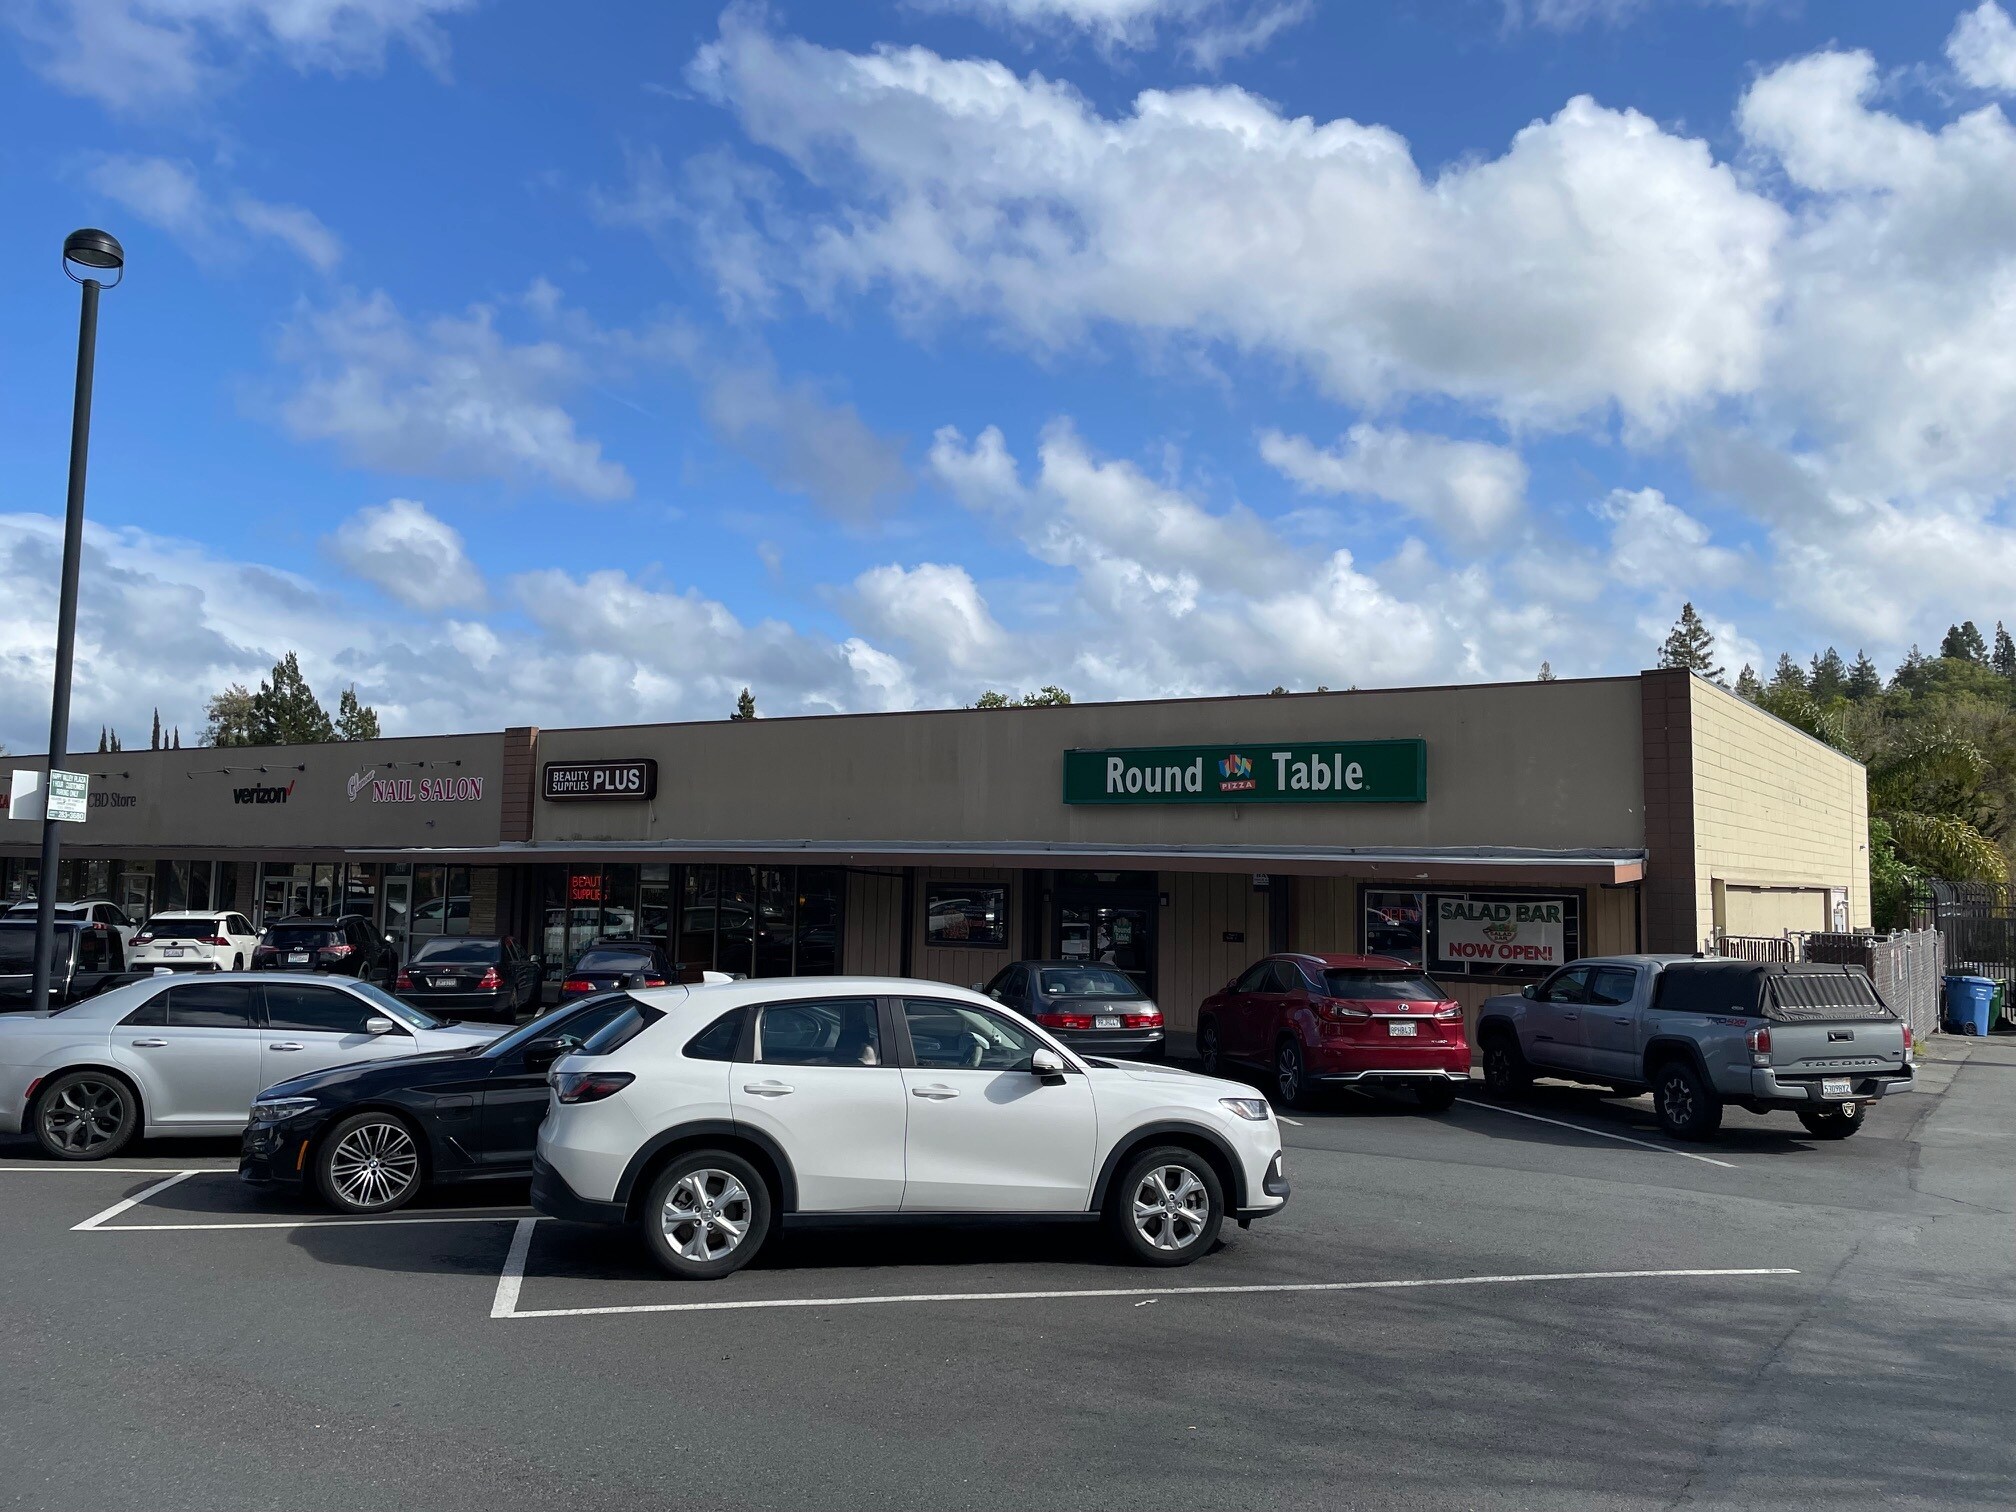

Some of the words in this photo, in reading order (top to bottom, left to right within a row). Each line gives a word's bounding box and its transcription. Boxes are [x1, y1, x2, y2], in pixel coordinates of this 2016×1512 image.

[553, 771, 590, 782] BEAUTY
[593, 768, 640, 791] PLUS
[1106, 756, 1203, 794] Round
[1271, 751, 1364, 791] Table
[233, 782, 287, 804] verizon
[372, 779, 416, 803] NAIL
[418, 777, 484, 802] SALON
[552, 781, 590, 792] SUPPLIES
[1221, 781, 1253, 791] PIZZA
[88, 792, 109, 808] CBD
[110, 792, 137, 808] Store
[572, 876, 608, 888] BEAUT
[1380, 908, 1418, 922] OPEN
[1440, 902, 1511, 922] SALAD
[1516, 904, 1562, 924] BAR
[1449, 942, 1495, 959] NOW
[1498, 945, 1552, 962] OPEN!
[1705, 1016, 1727, 1025] TRD
[1801, 1060, 1878, 1068] TACOMA
